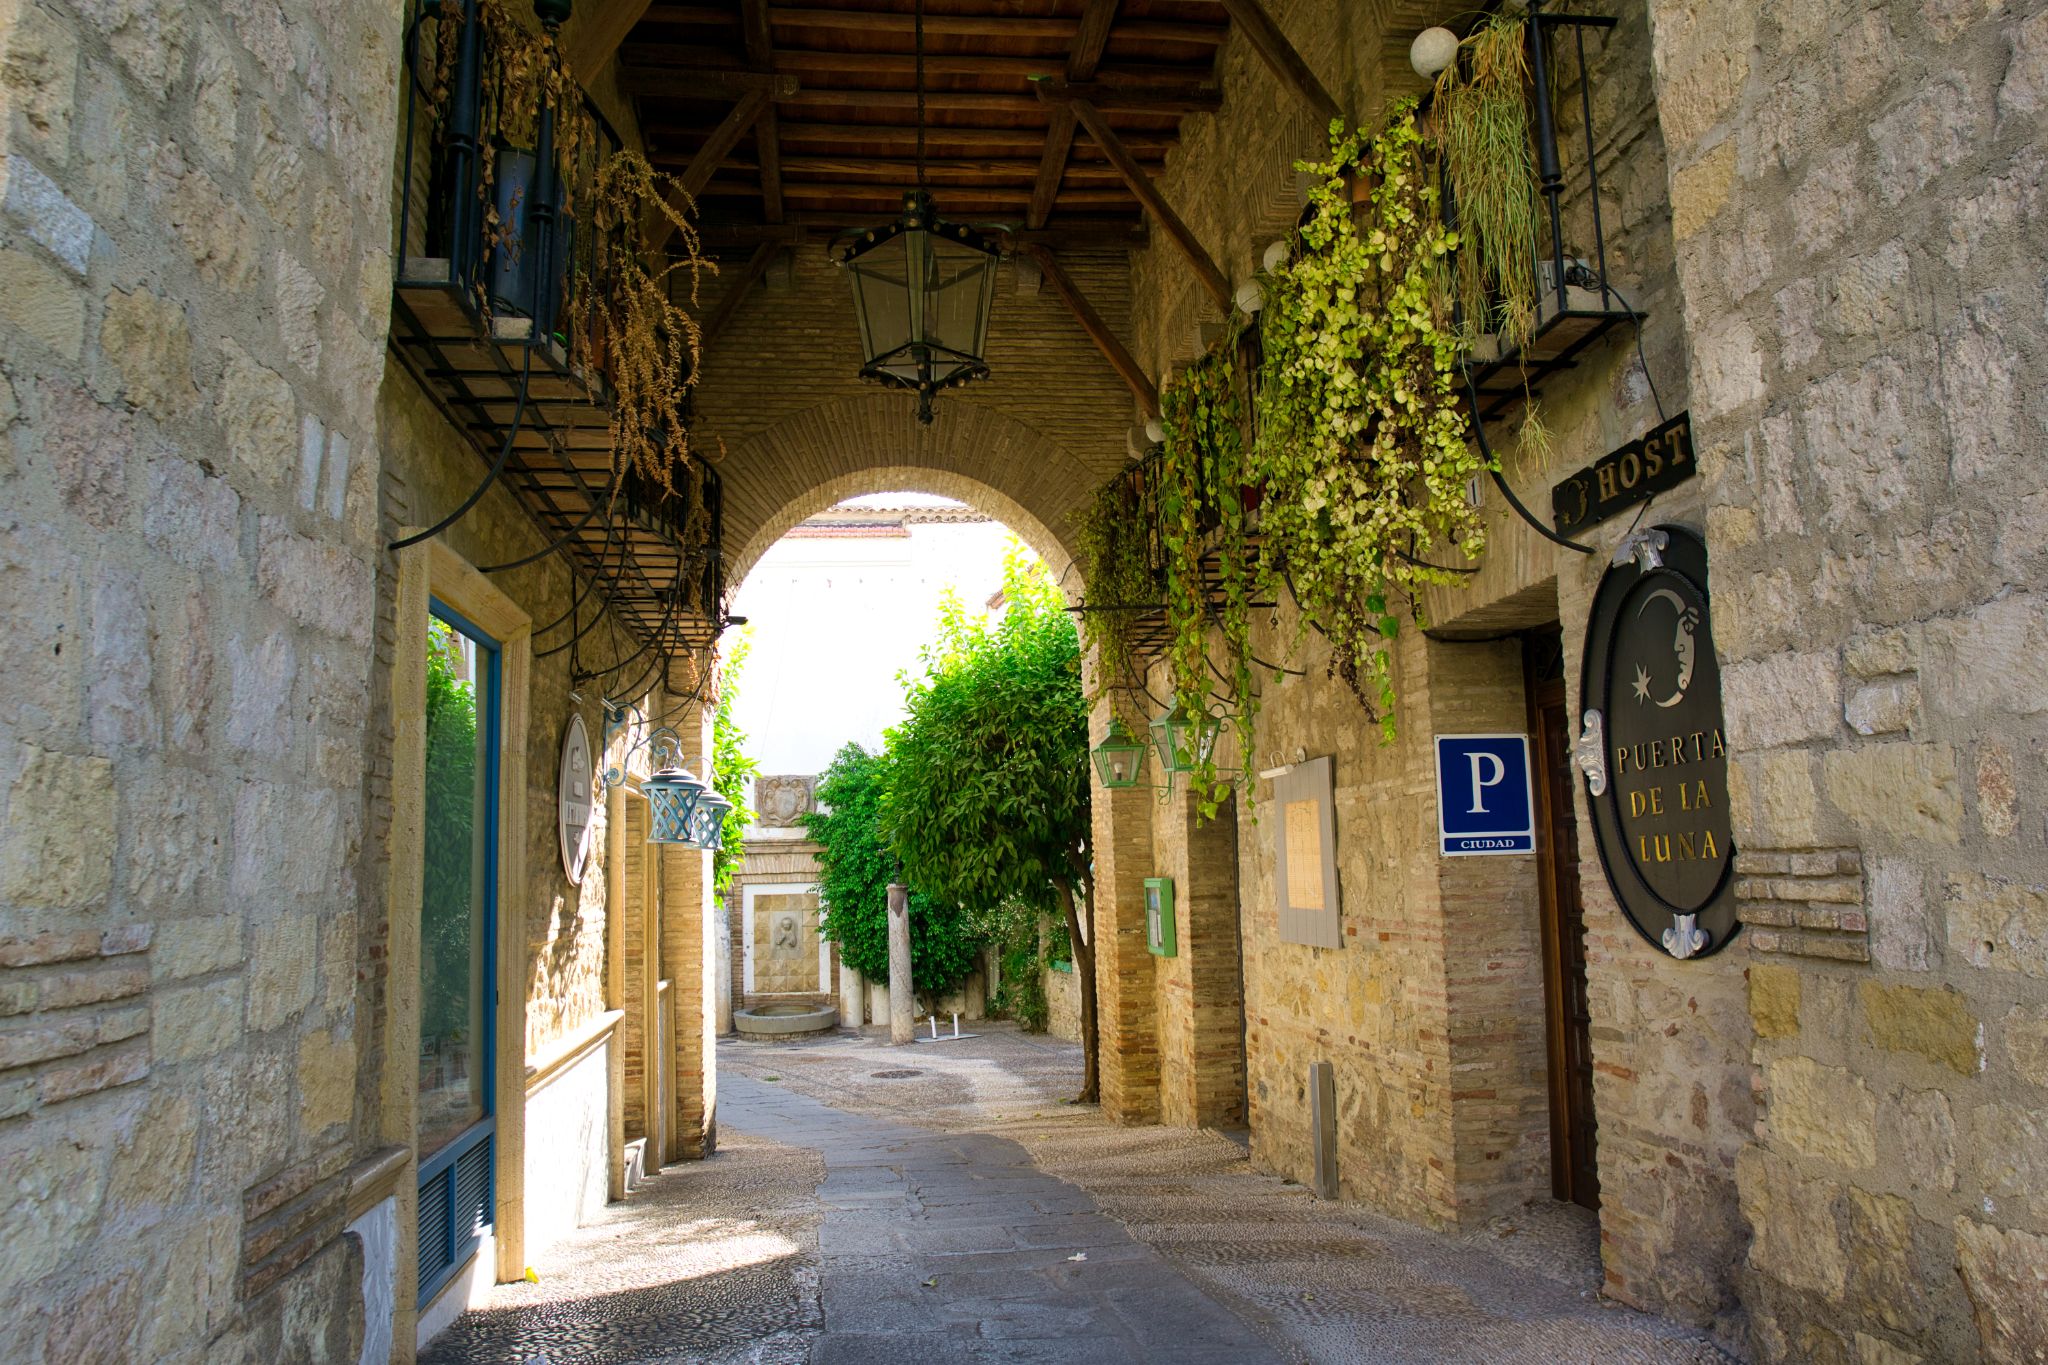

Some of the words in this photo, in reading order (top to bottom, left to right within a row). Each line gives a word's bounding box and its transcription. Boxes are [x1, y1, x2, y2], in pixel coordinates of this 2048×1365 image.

[1595, 423, 1687, 502] HOST
[1616, 728, 1726, 774] PUERTA
[1463, 752, 1505, 814] P
[1630, 787, 1664, 818] DE
[1679, 779, 1712, 811] LA
[1460, 839, 1515, 849] CIUDAD
[1638, 830, 1719, 862] LUNA
